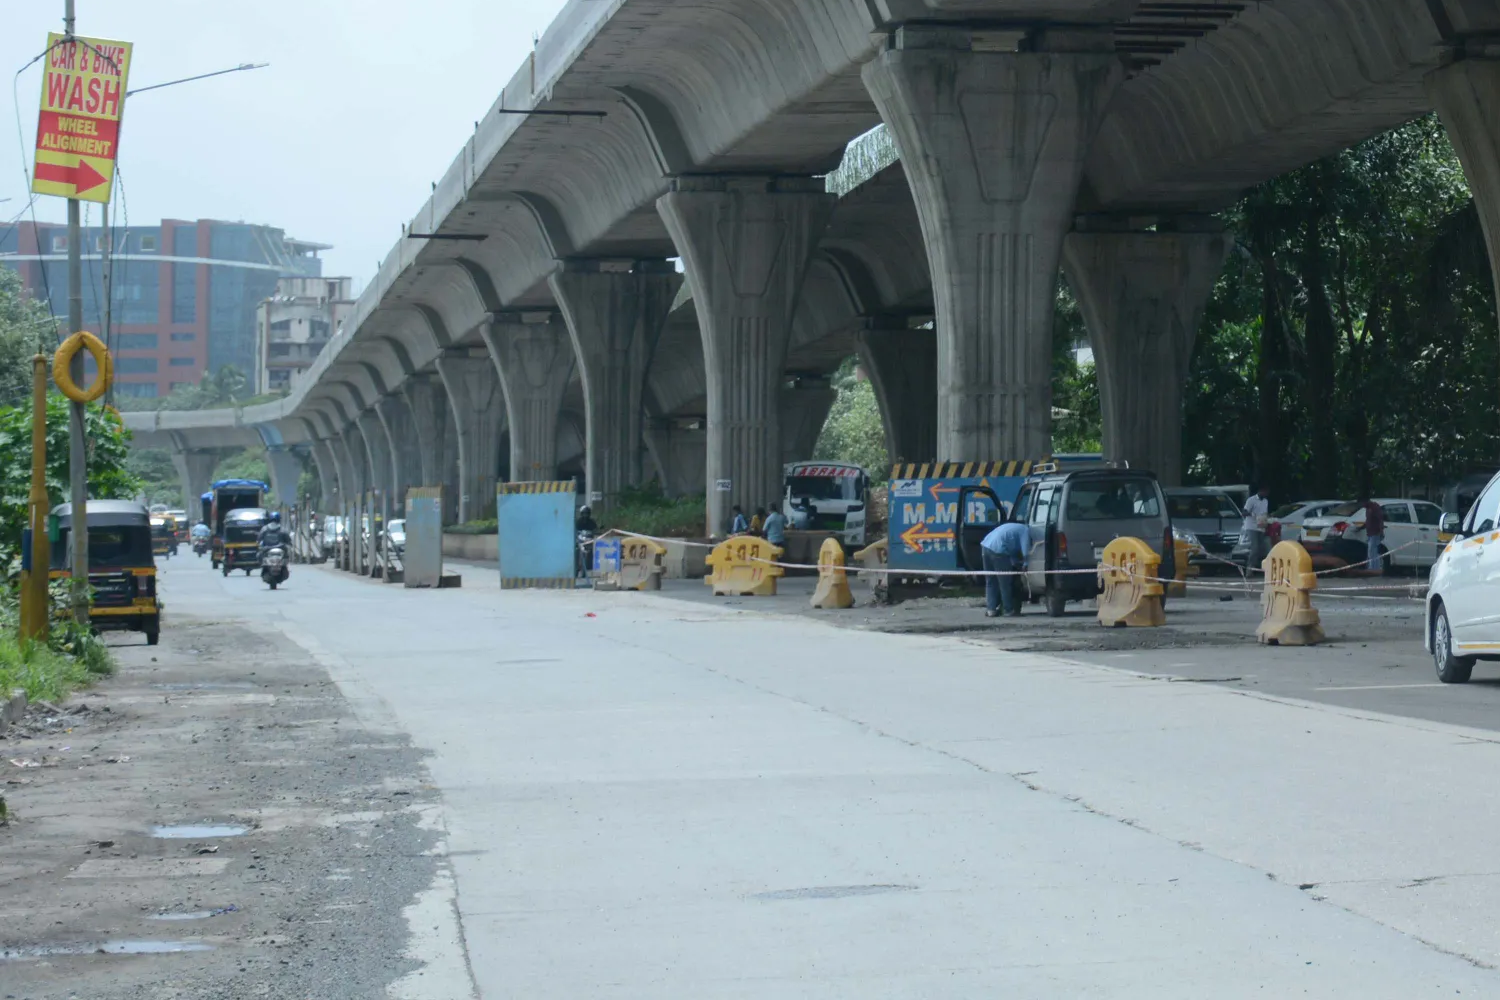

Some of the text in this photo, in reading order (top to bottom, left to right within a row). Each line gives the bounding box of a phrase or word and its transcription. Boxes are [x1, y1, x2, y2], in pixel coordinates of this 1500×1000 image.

[51, 39, 124, 76] CAR & BIKE
[48, 72, 120, 116] WASH
[58, 116, 98, 136] WHEEL
[41, 133, 111, 156] ALIGNMENT
